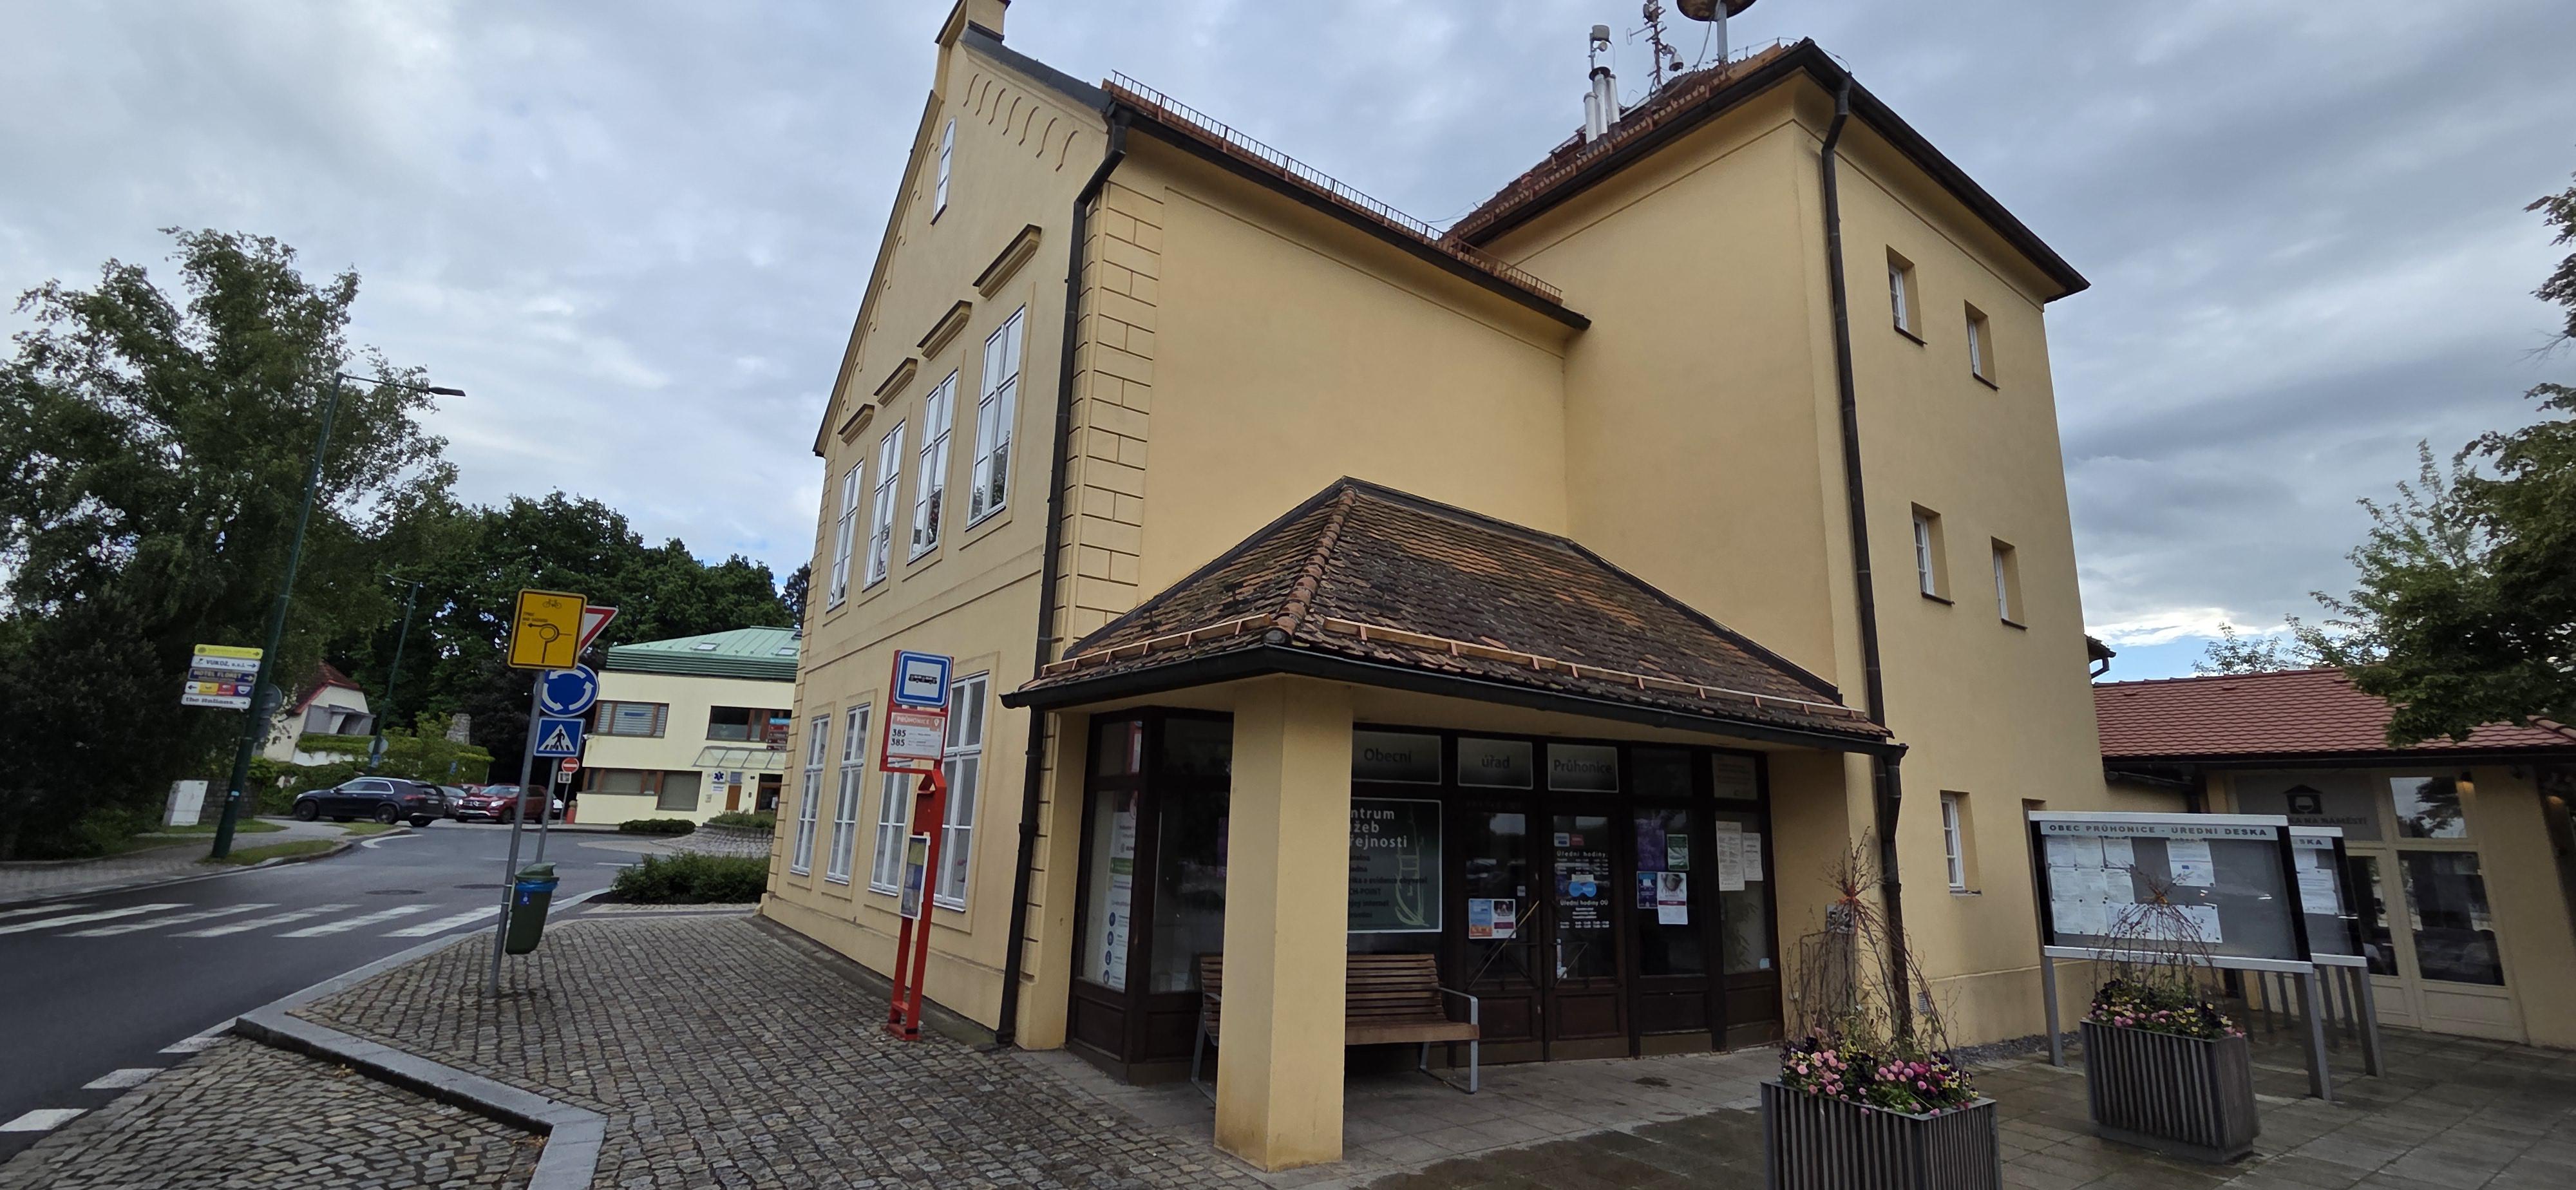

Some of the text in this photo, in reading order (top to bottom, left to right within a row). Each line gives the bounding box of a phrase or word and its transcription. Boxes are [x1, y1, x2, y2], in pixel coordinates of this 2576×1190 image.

[892, 728, 906, 737] 385
[891, 738, 905, 746] 385
[1364, 748, 1613, 774] Obecní úřad Průhonice
[1350, 808, 1395, 820] ntrum
[1351, 820, 1379, 833] žeb
[2086, 824, 2155, 833] PRŮHONICE
[2171, 826, 2218, 835] ÚŘEDNÍ
[2224, 827, 2268, 836] DESKA
[1350, 835, 1407, 851] řejnosti
